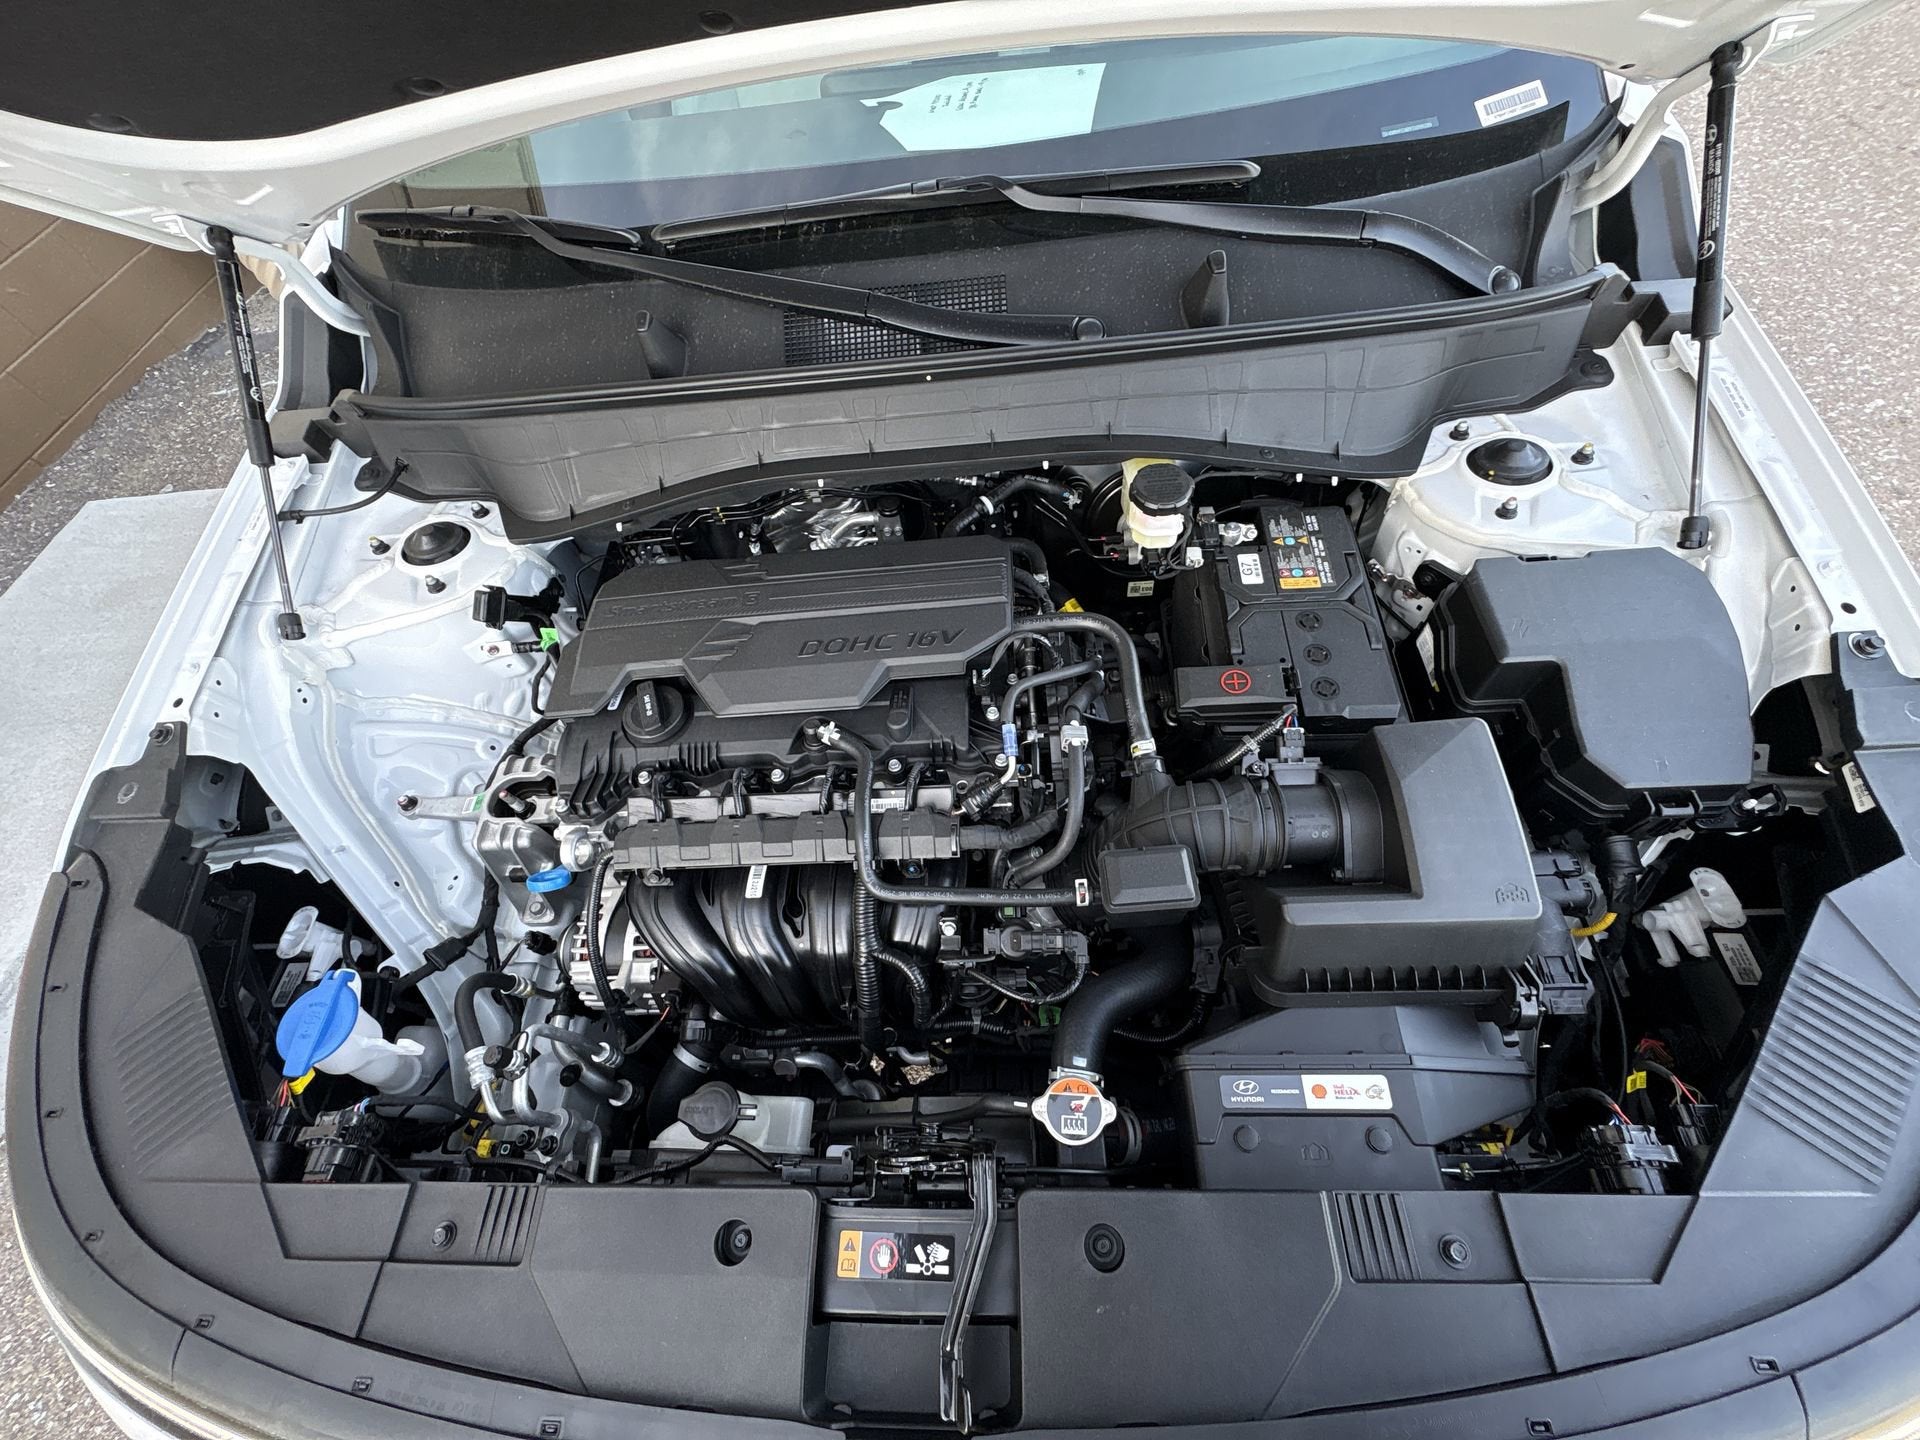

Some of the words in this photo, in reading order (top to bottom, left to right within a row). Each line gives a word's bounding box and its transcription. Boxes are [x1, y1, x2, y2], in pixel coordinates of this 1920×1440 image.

[1242, 559, 1252, 576] G7
[797, 633, 898, 659] DOHC
[906, 628, 967, 649] 16V
[1334, 1087, 1361, 1096] HELIX
